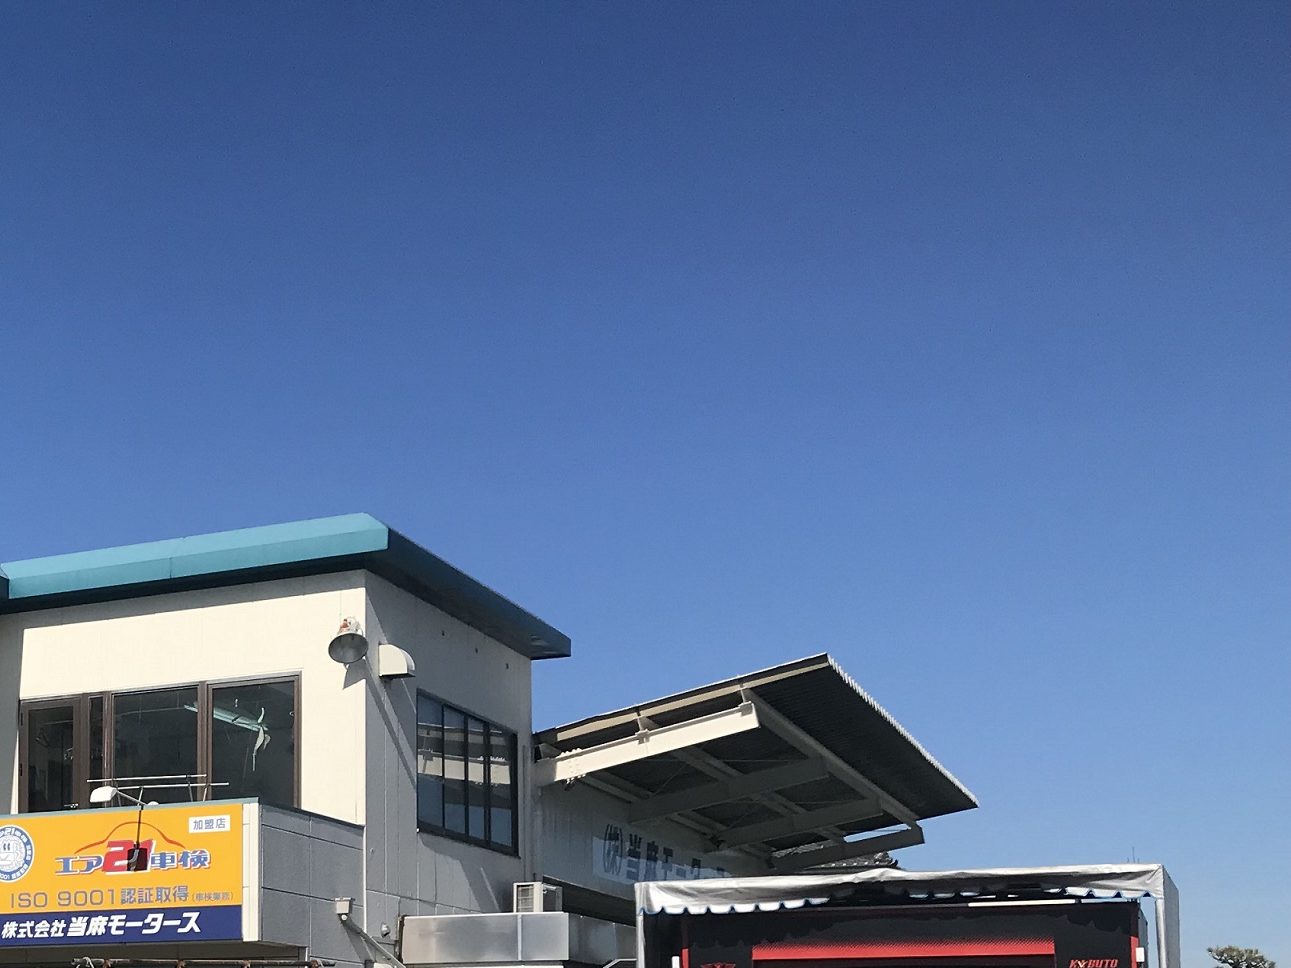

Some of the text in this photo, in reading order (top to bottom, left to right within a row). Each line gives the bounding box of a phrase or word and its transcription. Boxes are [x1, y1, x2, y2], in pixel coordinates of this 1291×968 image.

[193, 818, 226, 831] 加盟店
[10, 892, 48, 908] ISO
